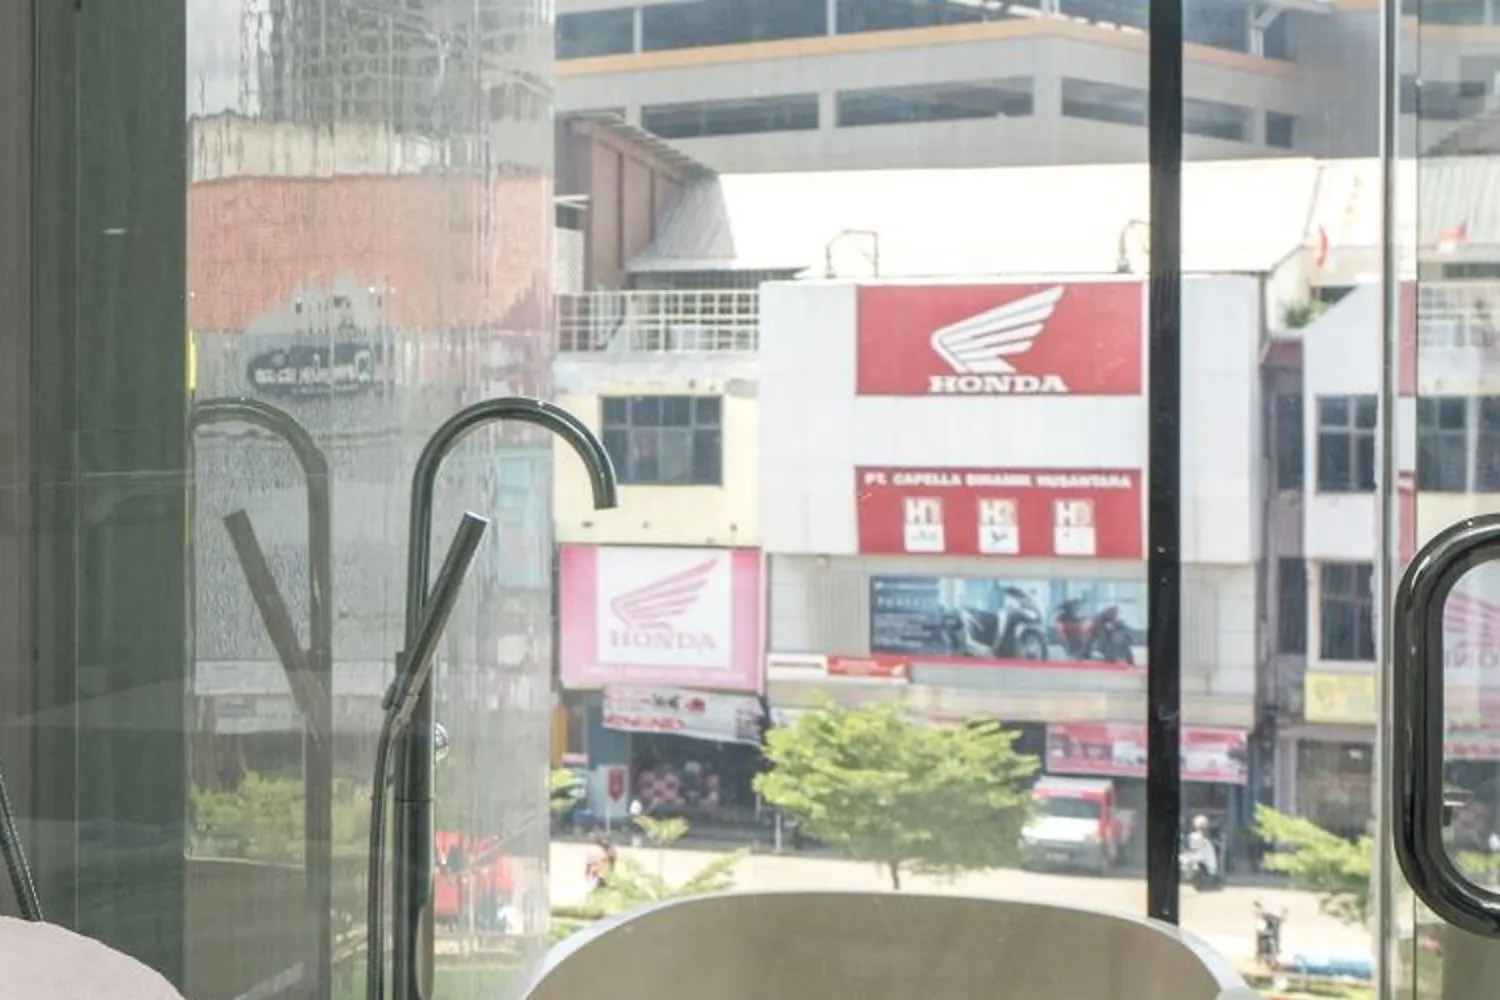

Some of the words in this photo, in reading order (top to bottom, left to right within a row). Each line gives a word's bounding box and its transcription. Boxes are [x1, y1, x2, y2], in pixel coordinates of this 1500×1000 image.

[928, 374, 1069, 393] HONDA
[892, 473, 962, 486] CAPELLA
[608, 629, 717, 650] HONDA
